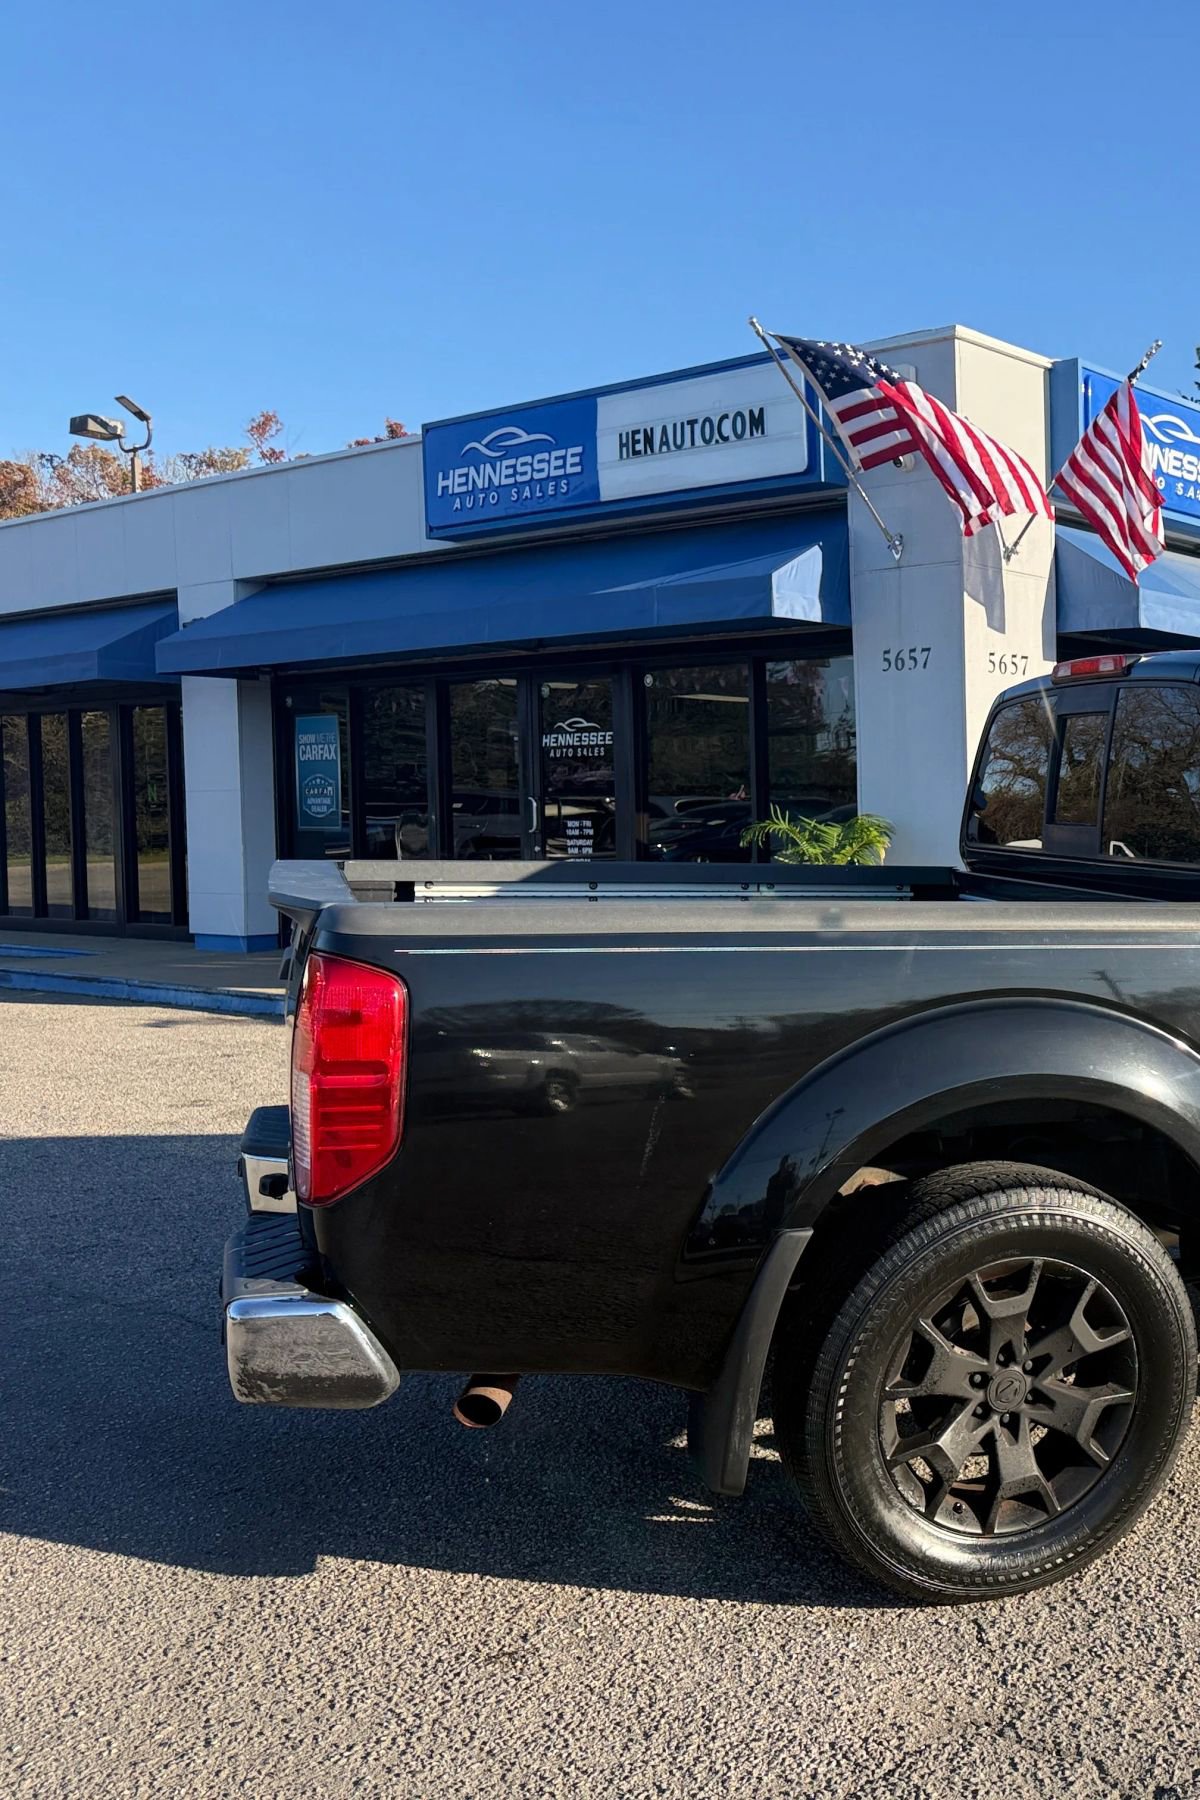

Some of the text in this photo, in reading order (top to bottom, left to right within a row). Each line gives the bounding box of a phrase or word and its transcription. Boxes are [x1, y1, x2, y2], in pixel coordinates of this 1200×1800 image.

[437, 446, 583, 497] HENNESSEE
[453, 480, 569, 511] AUTO SALES
[882, 647, 932, 672] 5657
[988, 652, 1029, 676] 5657
[298, 733, 316, 744] SHOW
[542, 731, 614, 748] HENNESSEE
[299, 744, 337, 761] CARFAX
[549, 747, 605, 758] AUTO SALES
[567, 820, 580, 828] MON
[583, 820, 592, 828] FRI
[566, 838, 593, 846] SATURDAY
